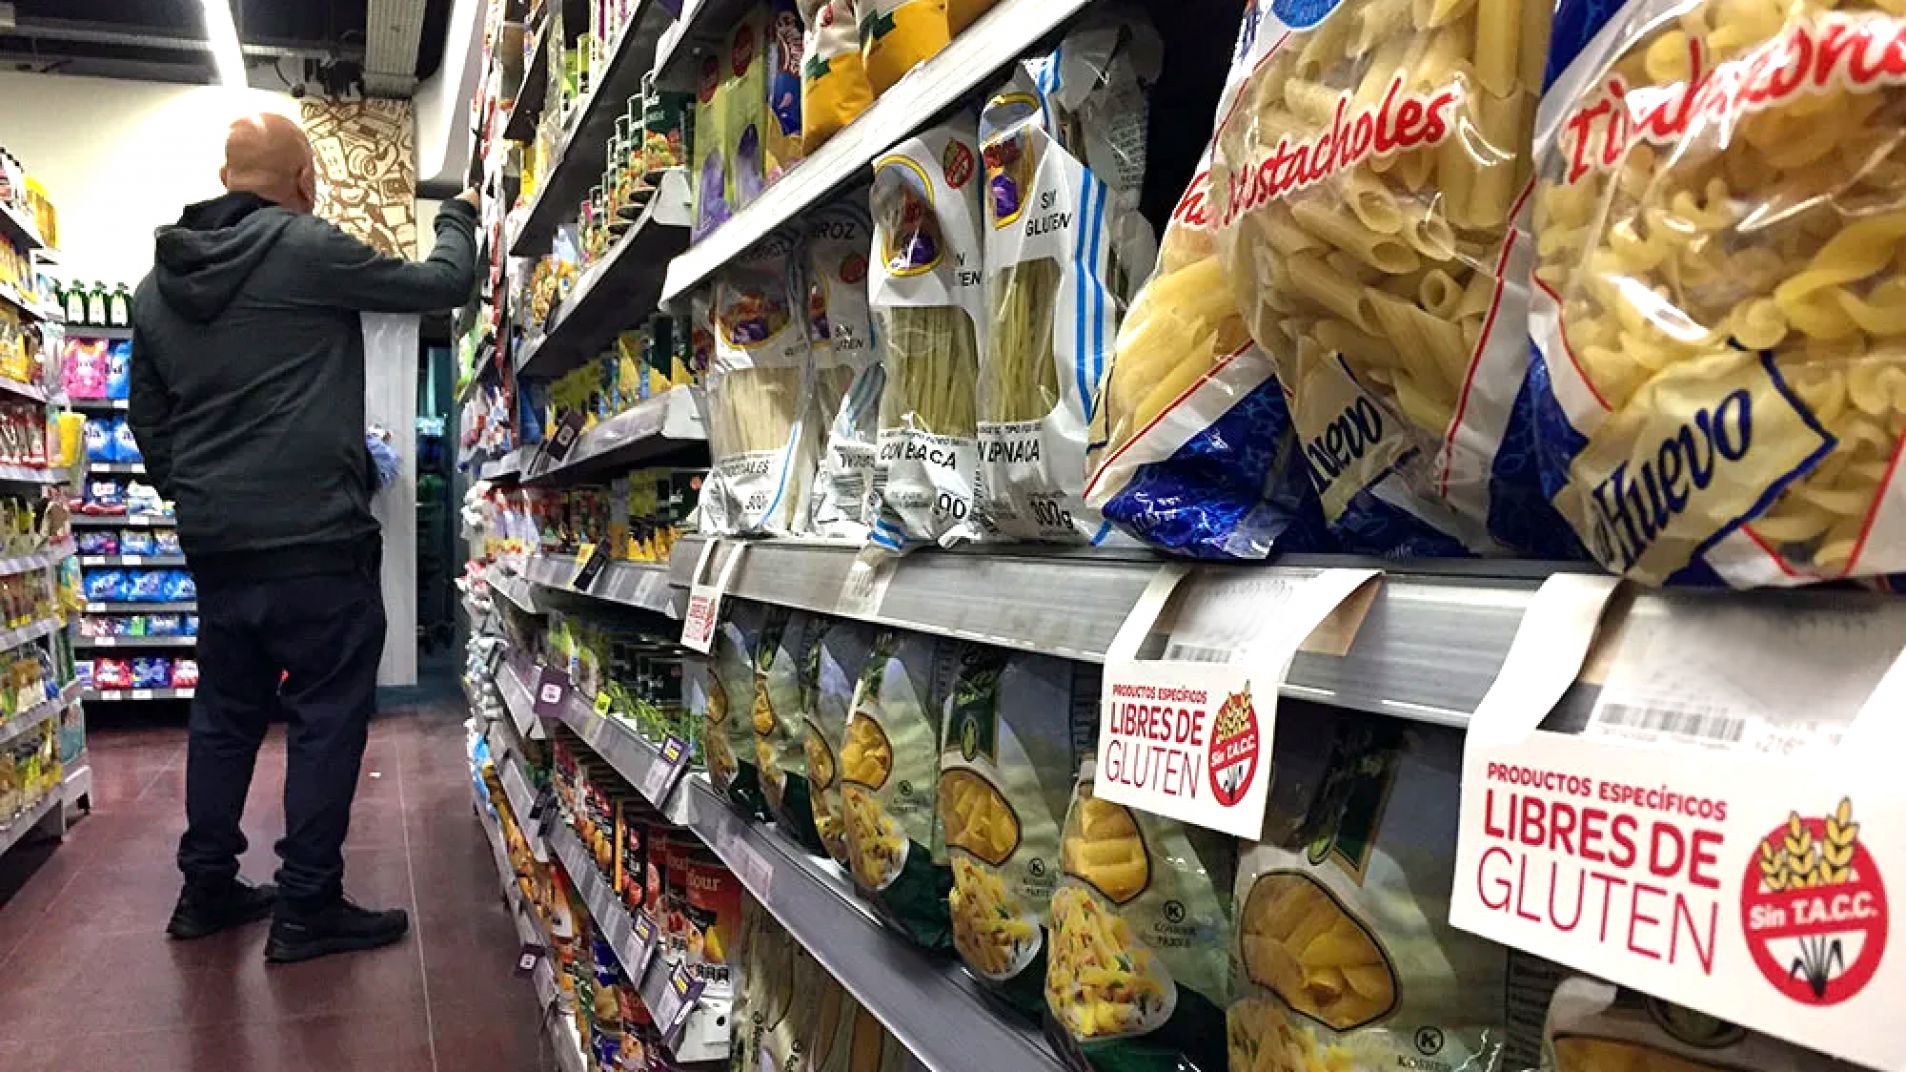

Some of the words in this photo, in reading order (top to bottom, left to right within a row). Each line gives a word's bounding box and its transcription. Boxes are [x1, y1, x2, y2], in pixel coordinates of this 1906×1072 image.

[1591, 388, 1751, 573] Huevo
[1112, 684, 1156, 700] PRODUCTOS
[1110, 702, 1174, 742] LIBRES
[1175, 708, 1206, 747] DE
[1105, 739, 1202, 799] GLUTEN
[1487, 761, 1592, 798] PRODUCTOS
[1598, 782, 1728, 822] ESPECÍFICOS
[1483, 787, 1639, 869] LIBRES
[1648, 821, 1724, 889] DE
[1476, 846, 1719, 976] GLUTEN
[1750, 903, 1787, 930] Sin
[1791, 891, 1880, 925] T.A.C.C.
